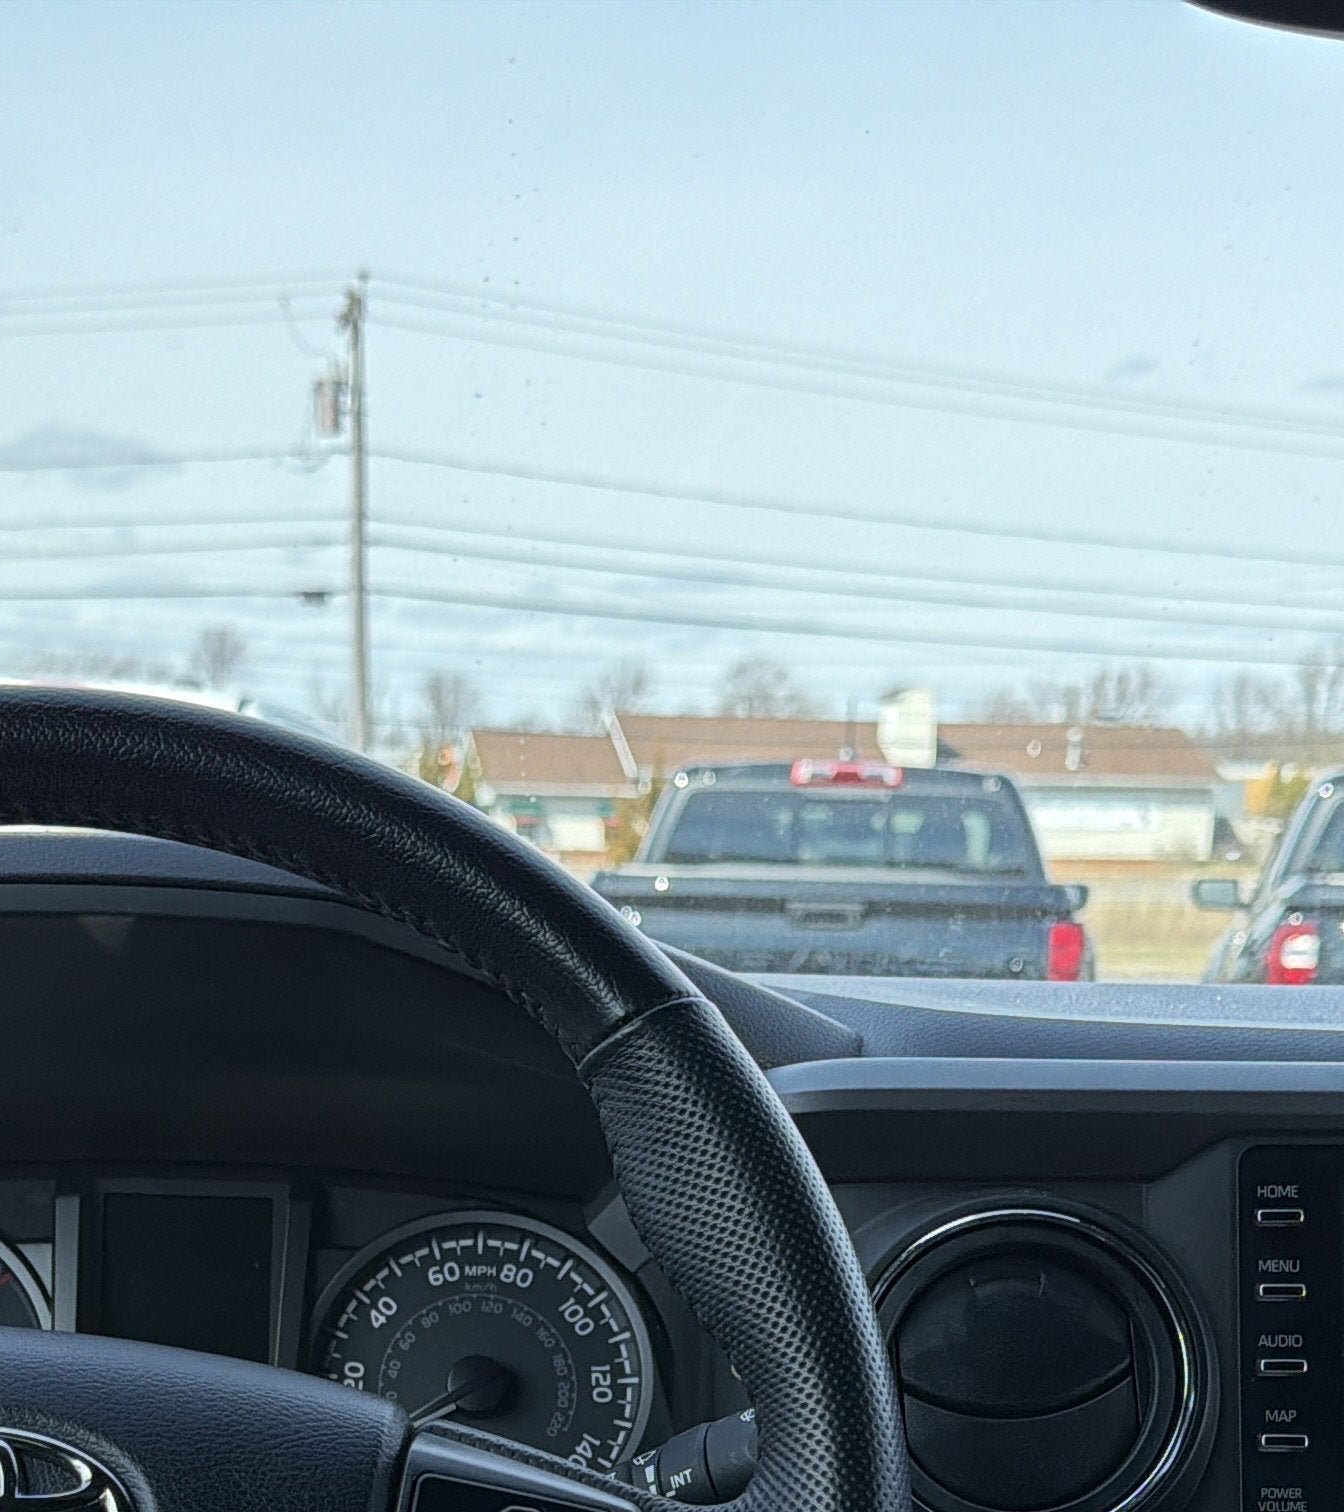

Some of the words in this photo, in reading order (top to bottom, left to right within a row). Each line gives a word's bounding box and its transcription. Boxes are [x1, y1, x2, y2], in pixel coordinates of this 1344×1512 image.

[1256, 1185, 1300, 1198] HOME
[428, 1261, 460, 1286] 60
[464, 1265, 497, 1277] MPH
[1258, 1259, 1300, 1273] MENU
[499, 1263, 533, 1288] 80
[464, 1282, 497, 1292] km/h
[370, 1296, 397, 1329] 40
[449, 1301, 472, 1316] 100
[481, 1301, 503, 1314] 120
[421, 1312, 439, 1329] 80
[510, 1308, 533, 1327] 140
[557, 1296, 595, 1337] 100
[1258, 1334, 1303, 1348] AUDIO
[388, 1360, 401, 1379] 40
[591, 1365, 613, 1403] 120
[1265, 1409, 1297, 1423] MAP
[669, 1468, 693, 1490] INT
[1260, 1488, 1302, 1500] POWER
[1257, 1501, 1308, 1512] VOLUME
